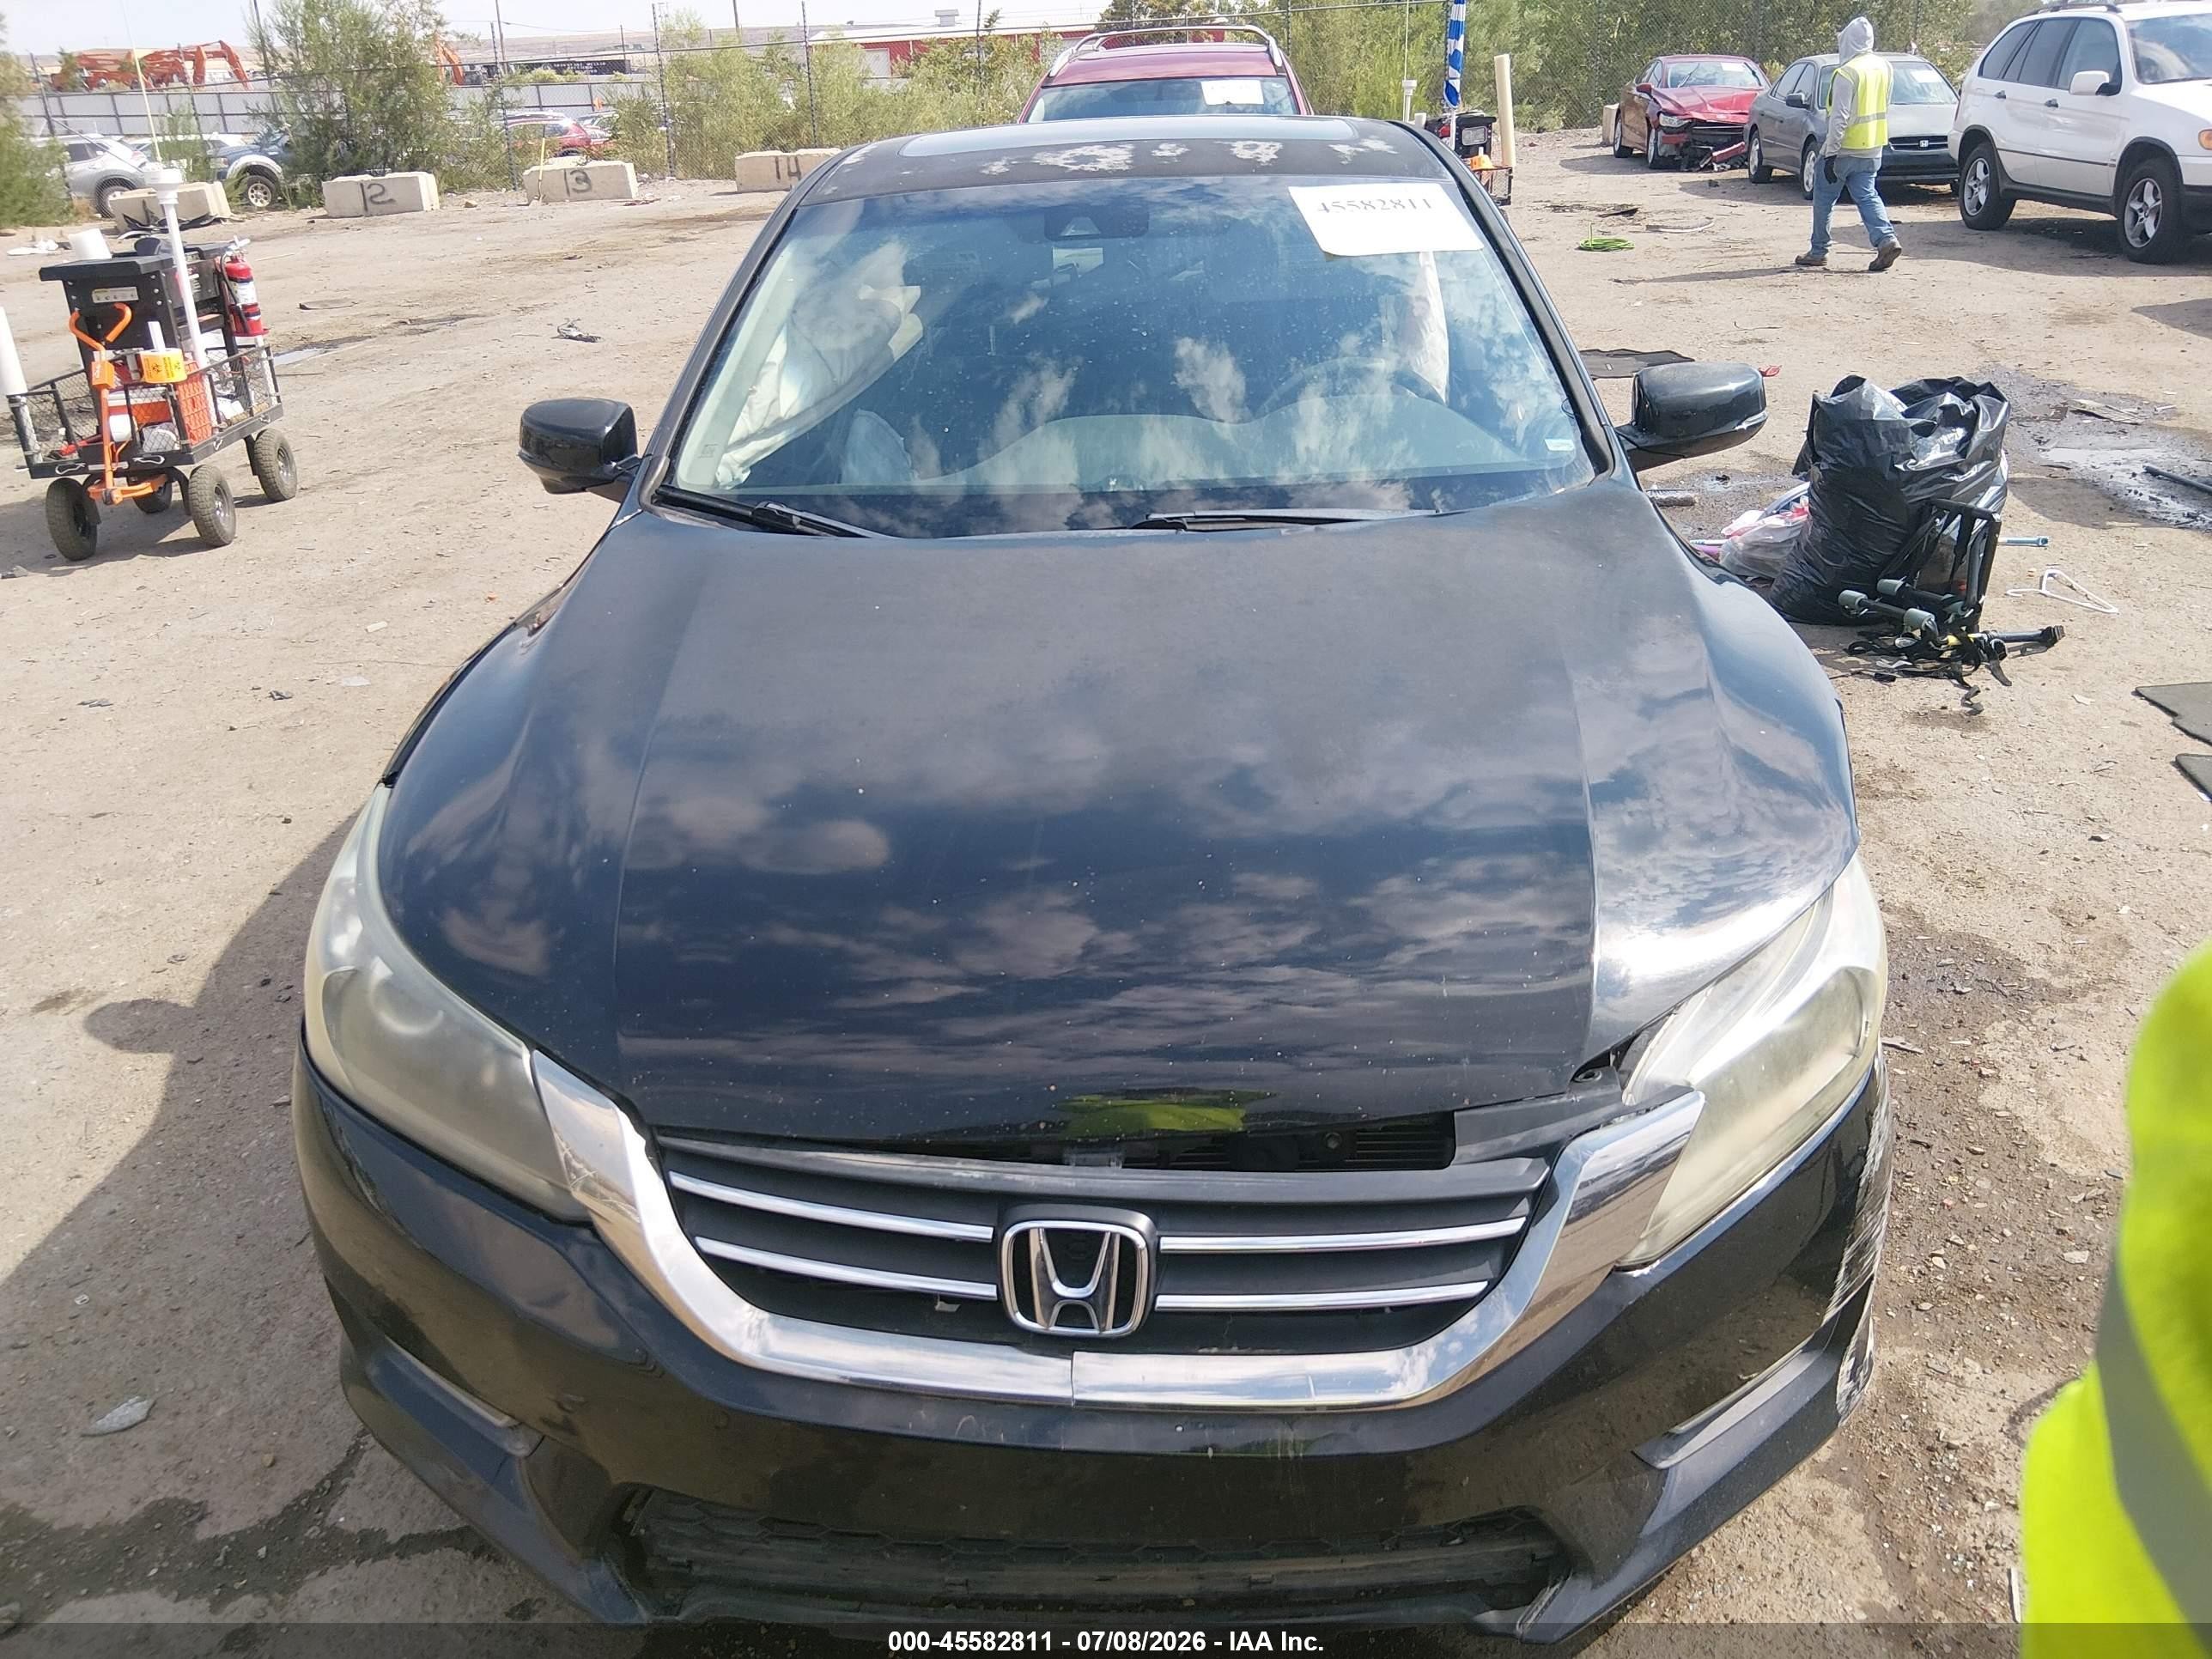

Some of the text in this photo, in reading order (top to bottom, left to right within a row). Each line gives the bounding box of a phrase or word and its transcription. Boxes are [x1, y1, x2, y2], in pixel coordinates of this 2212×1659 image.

[563, 168, 592, 198] 13
[775, 156, 802, 182] 14
[360, 182, 397, 212] 12
